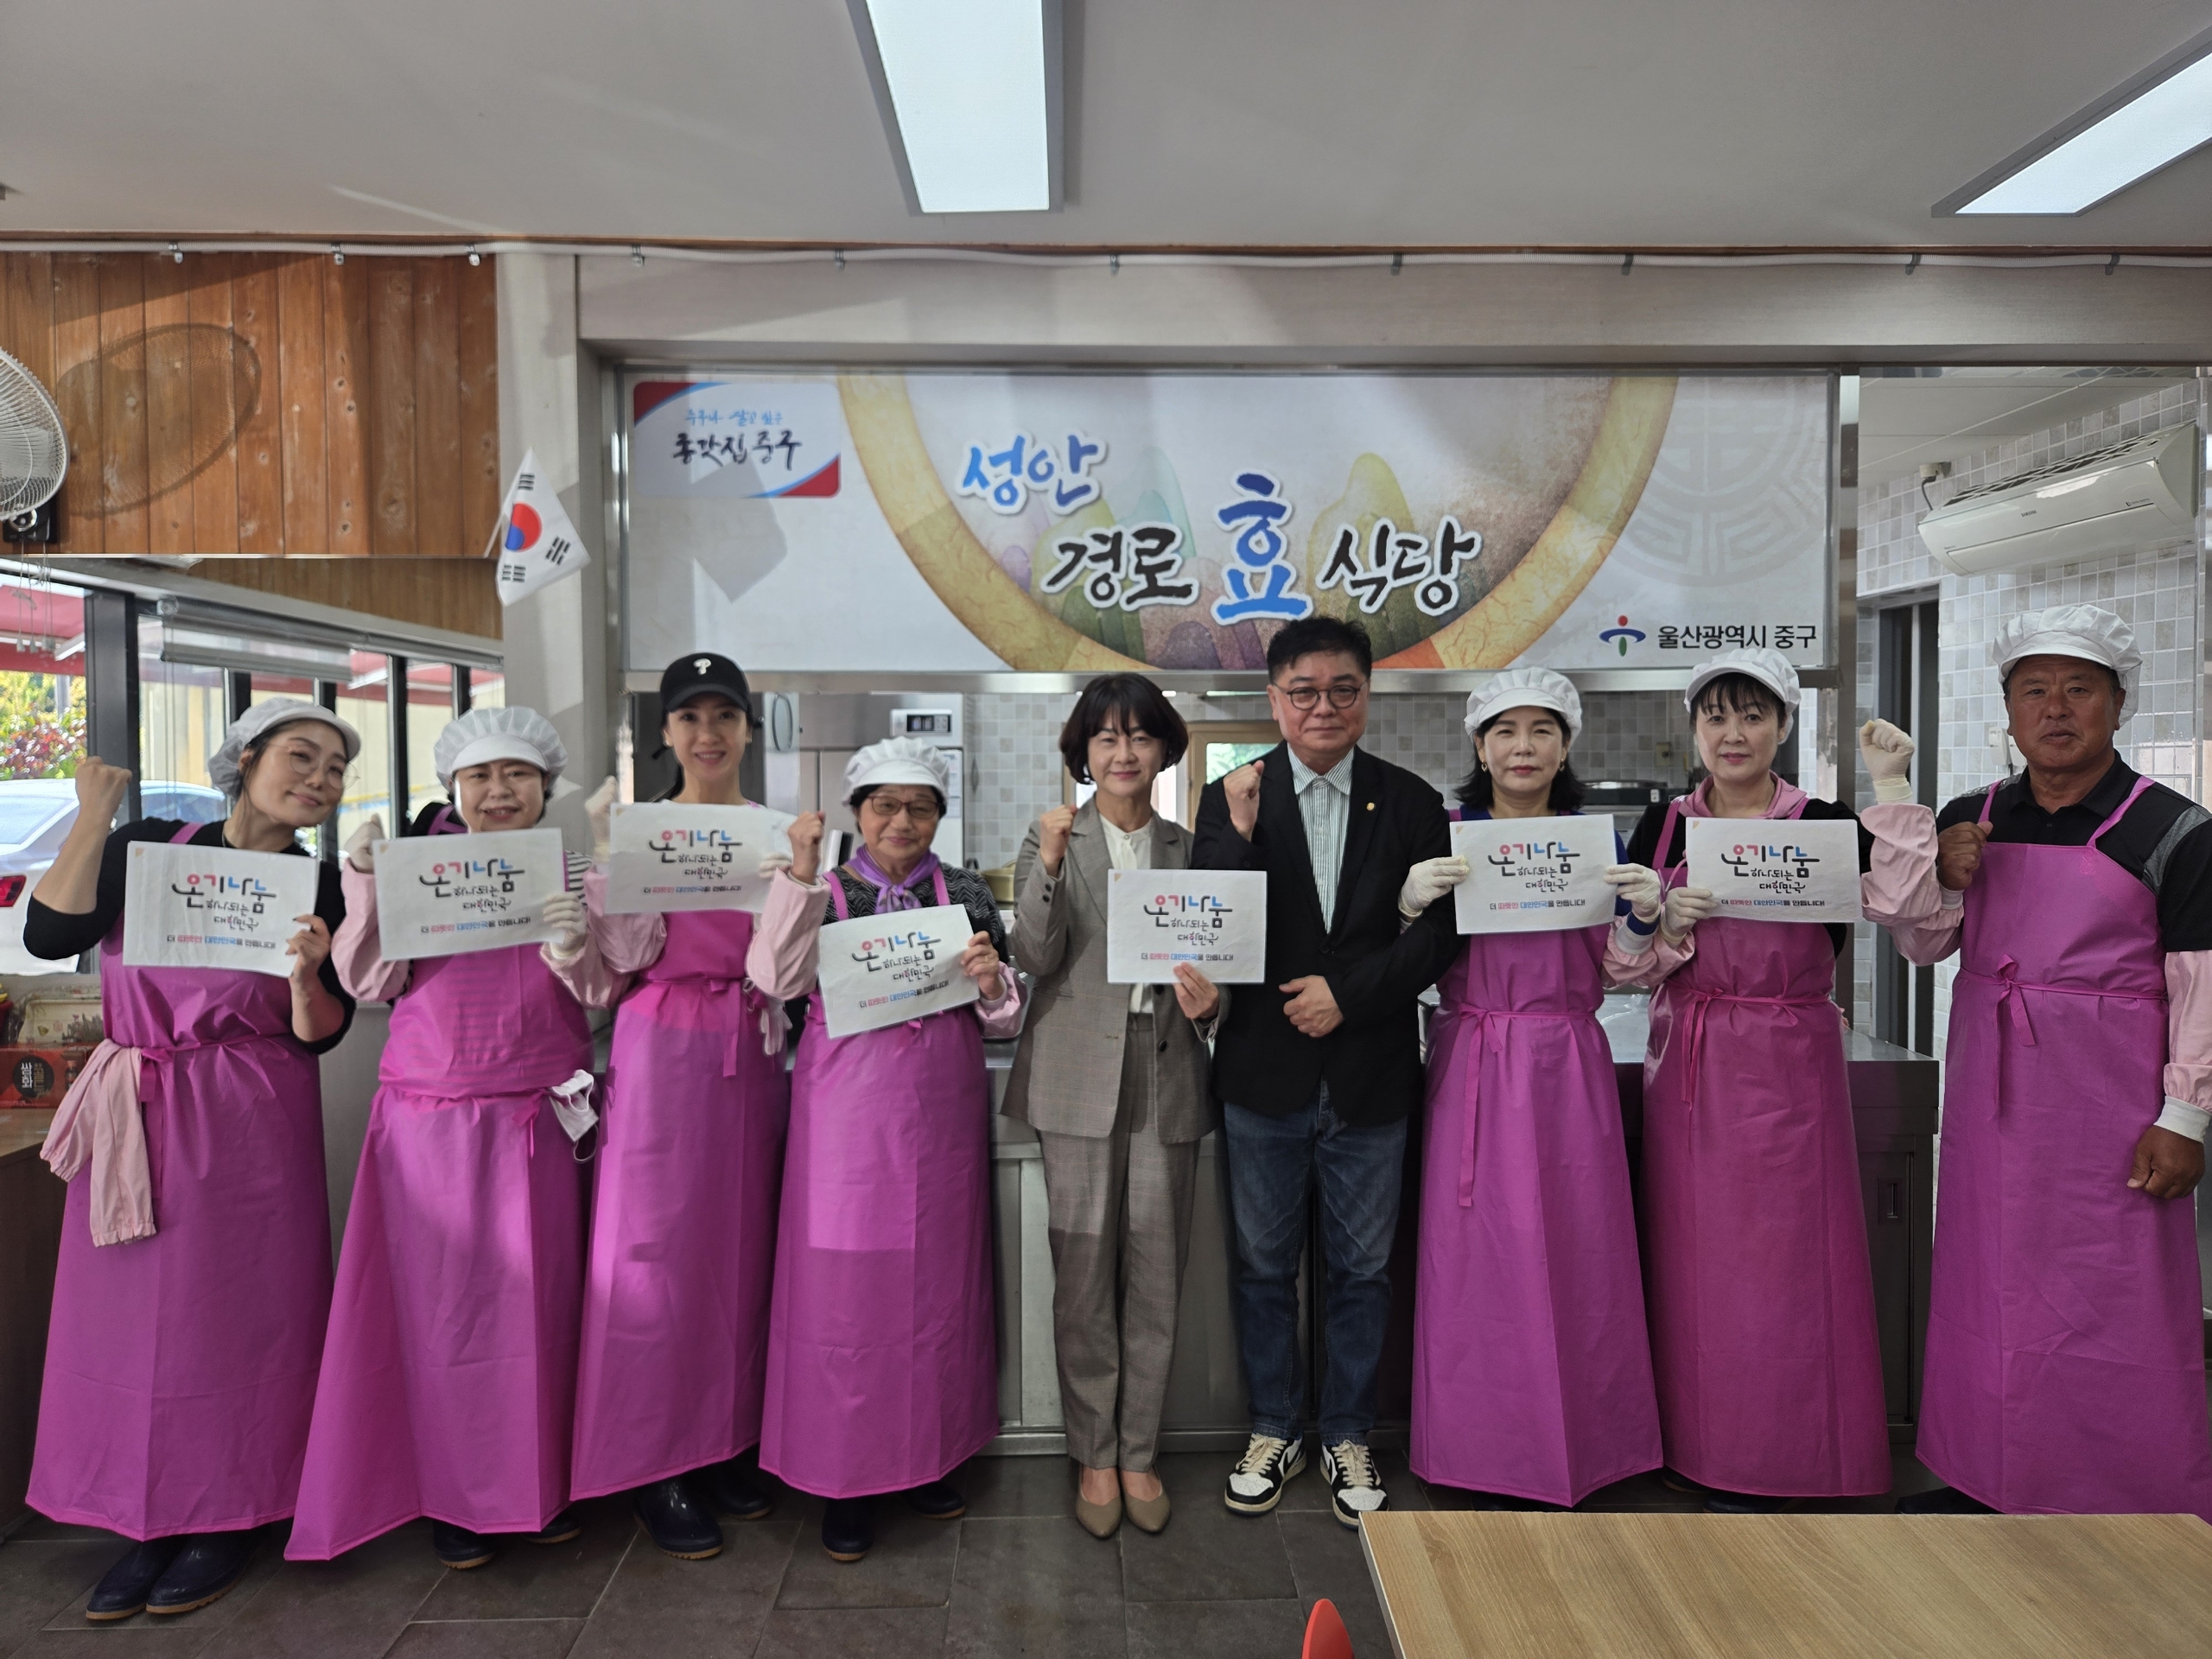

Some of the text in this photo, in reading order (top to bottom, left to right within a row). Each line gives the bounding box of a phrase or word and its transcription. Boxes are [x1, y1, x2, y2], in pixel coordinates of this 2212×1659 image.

[673, 429, 803, 471] 종갓집 중구
[962, 435, 1098, 506] 성안
[1046, 473, 1475, 620] 경로 효 식당
[1657, 625, 1817, 649] 울산광역시 중구
[649, 830, 743, 863] 온기나눔
[1488, 842, 1580, 877] 온기나눔
[1720, 844, 1820, 878] 온기나눔
[419, 858, 525, 898] 온기나눔
[684, 866, 728, 880] 대한민국
[1525, 879, 1568, 893] 대한민국
[1759, 880, 1806, 893] 대한민국
[171, 873, 276, 914] 온기나눔
[463, 897, 512, 913] 대한민국
[214, 915, 259, 932] 대한민국
[1143, 894, 1233, 928] 온기나눔
[852, 931, 942, 973] 온기나눔
[1177, 931, 1218, 946] 대한민국
[893, 965, 934, 982] 대한민국
[860, 1001, 867, 1009] 더
